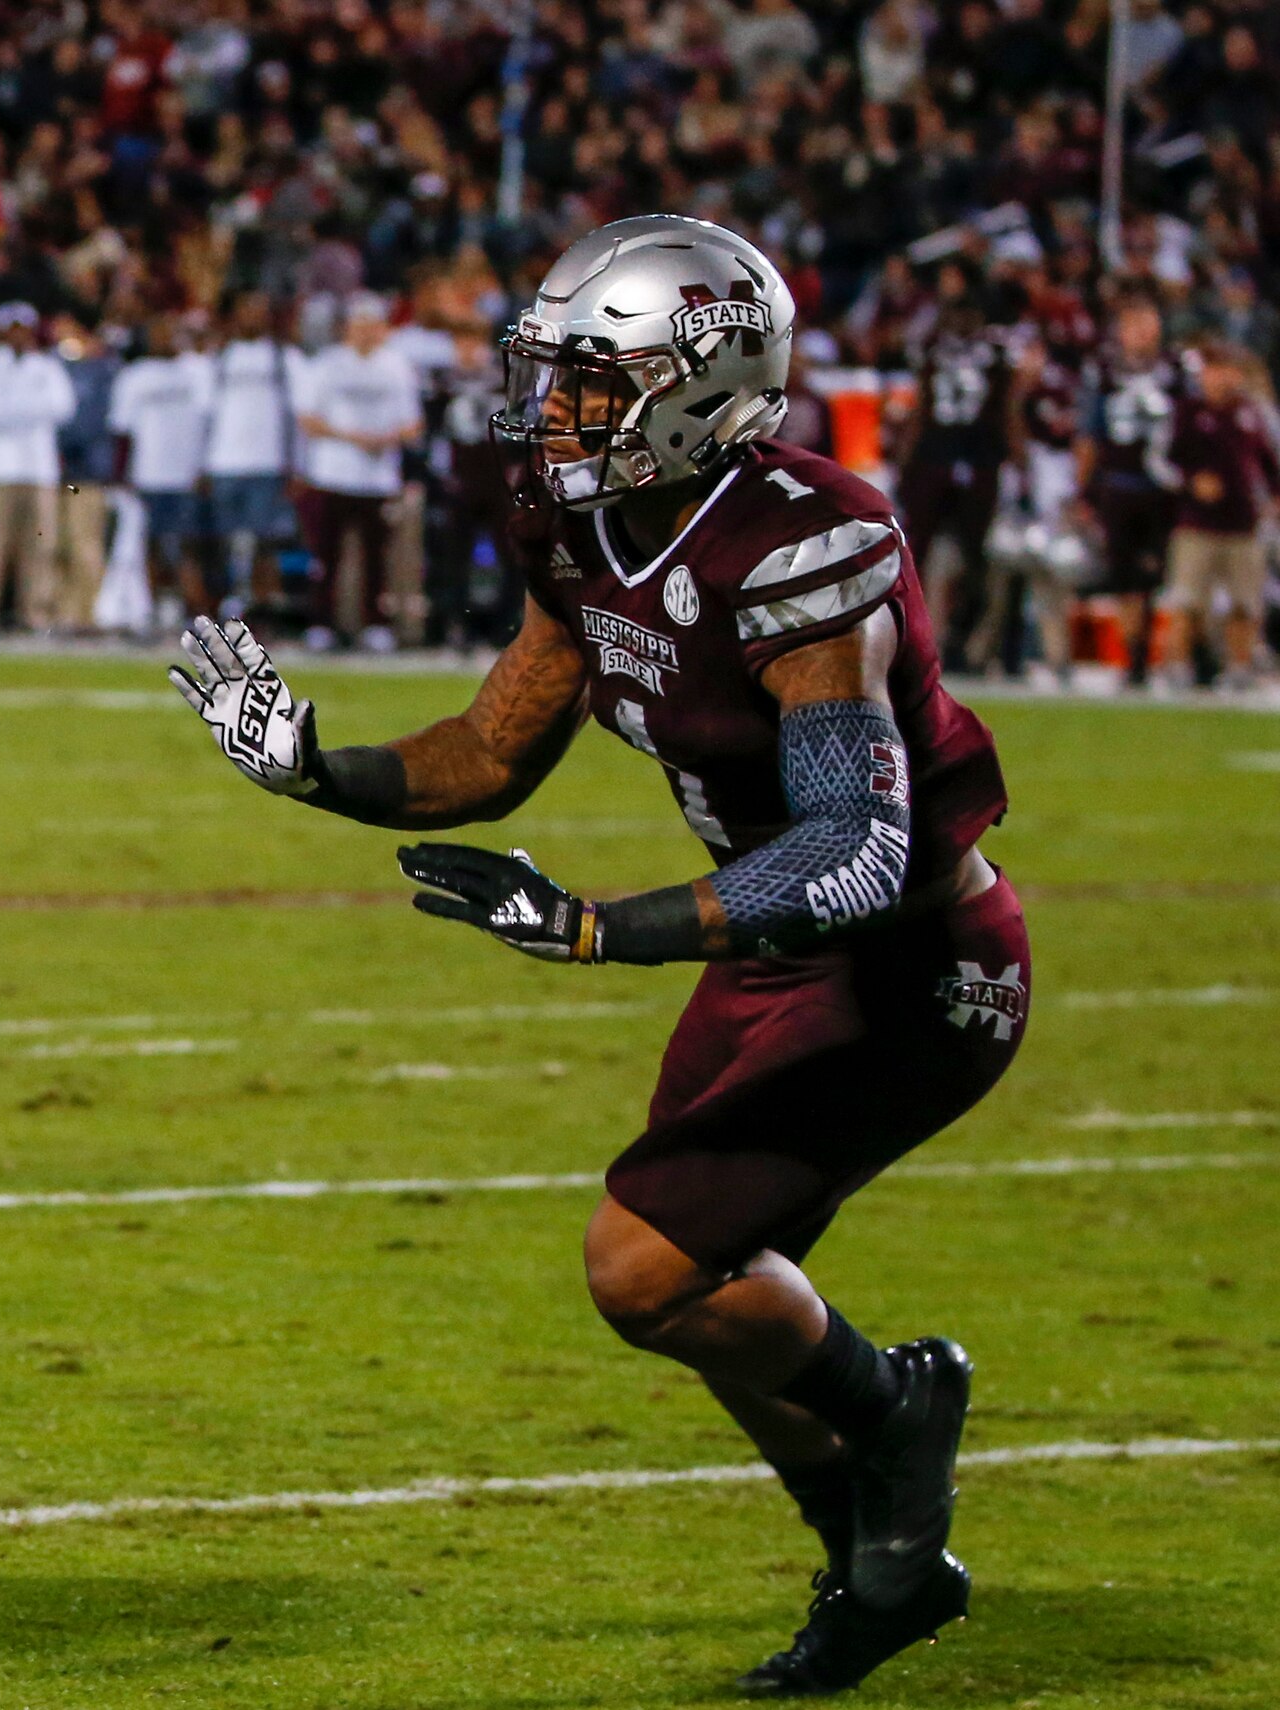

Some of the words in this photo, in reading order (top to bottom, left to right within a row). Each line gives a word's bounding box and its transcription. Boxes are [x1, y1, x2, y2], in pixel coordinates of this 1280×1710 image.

[690, 304, 760, 333] STATE
[765, 468, 816, 500] 1
[581, 611, 680, 667] MISSISSIPPI
[608, 652, 649, 684] STATE
[961, 985, 1017, 1014] STATE
